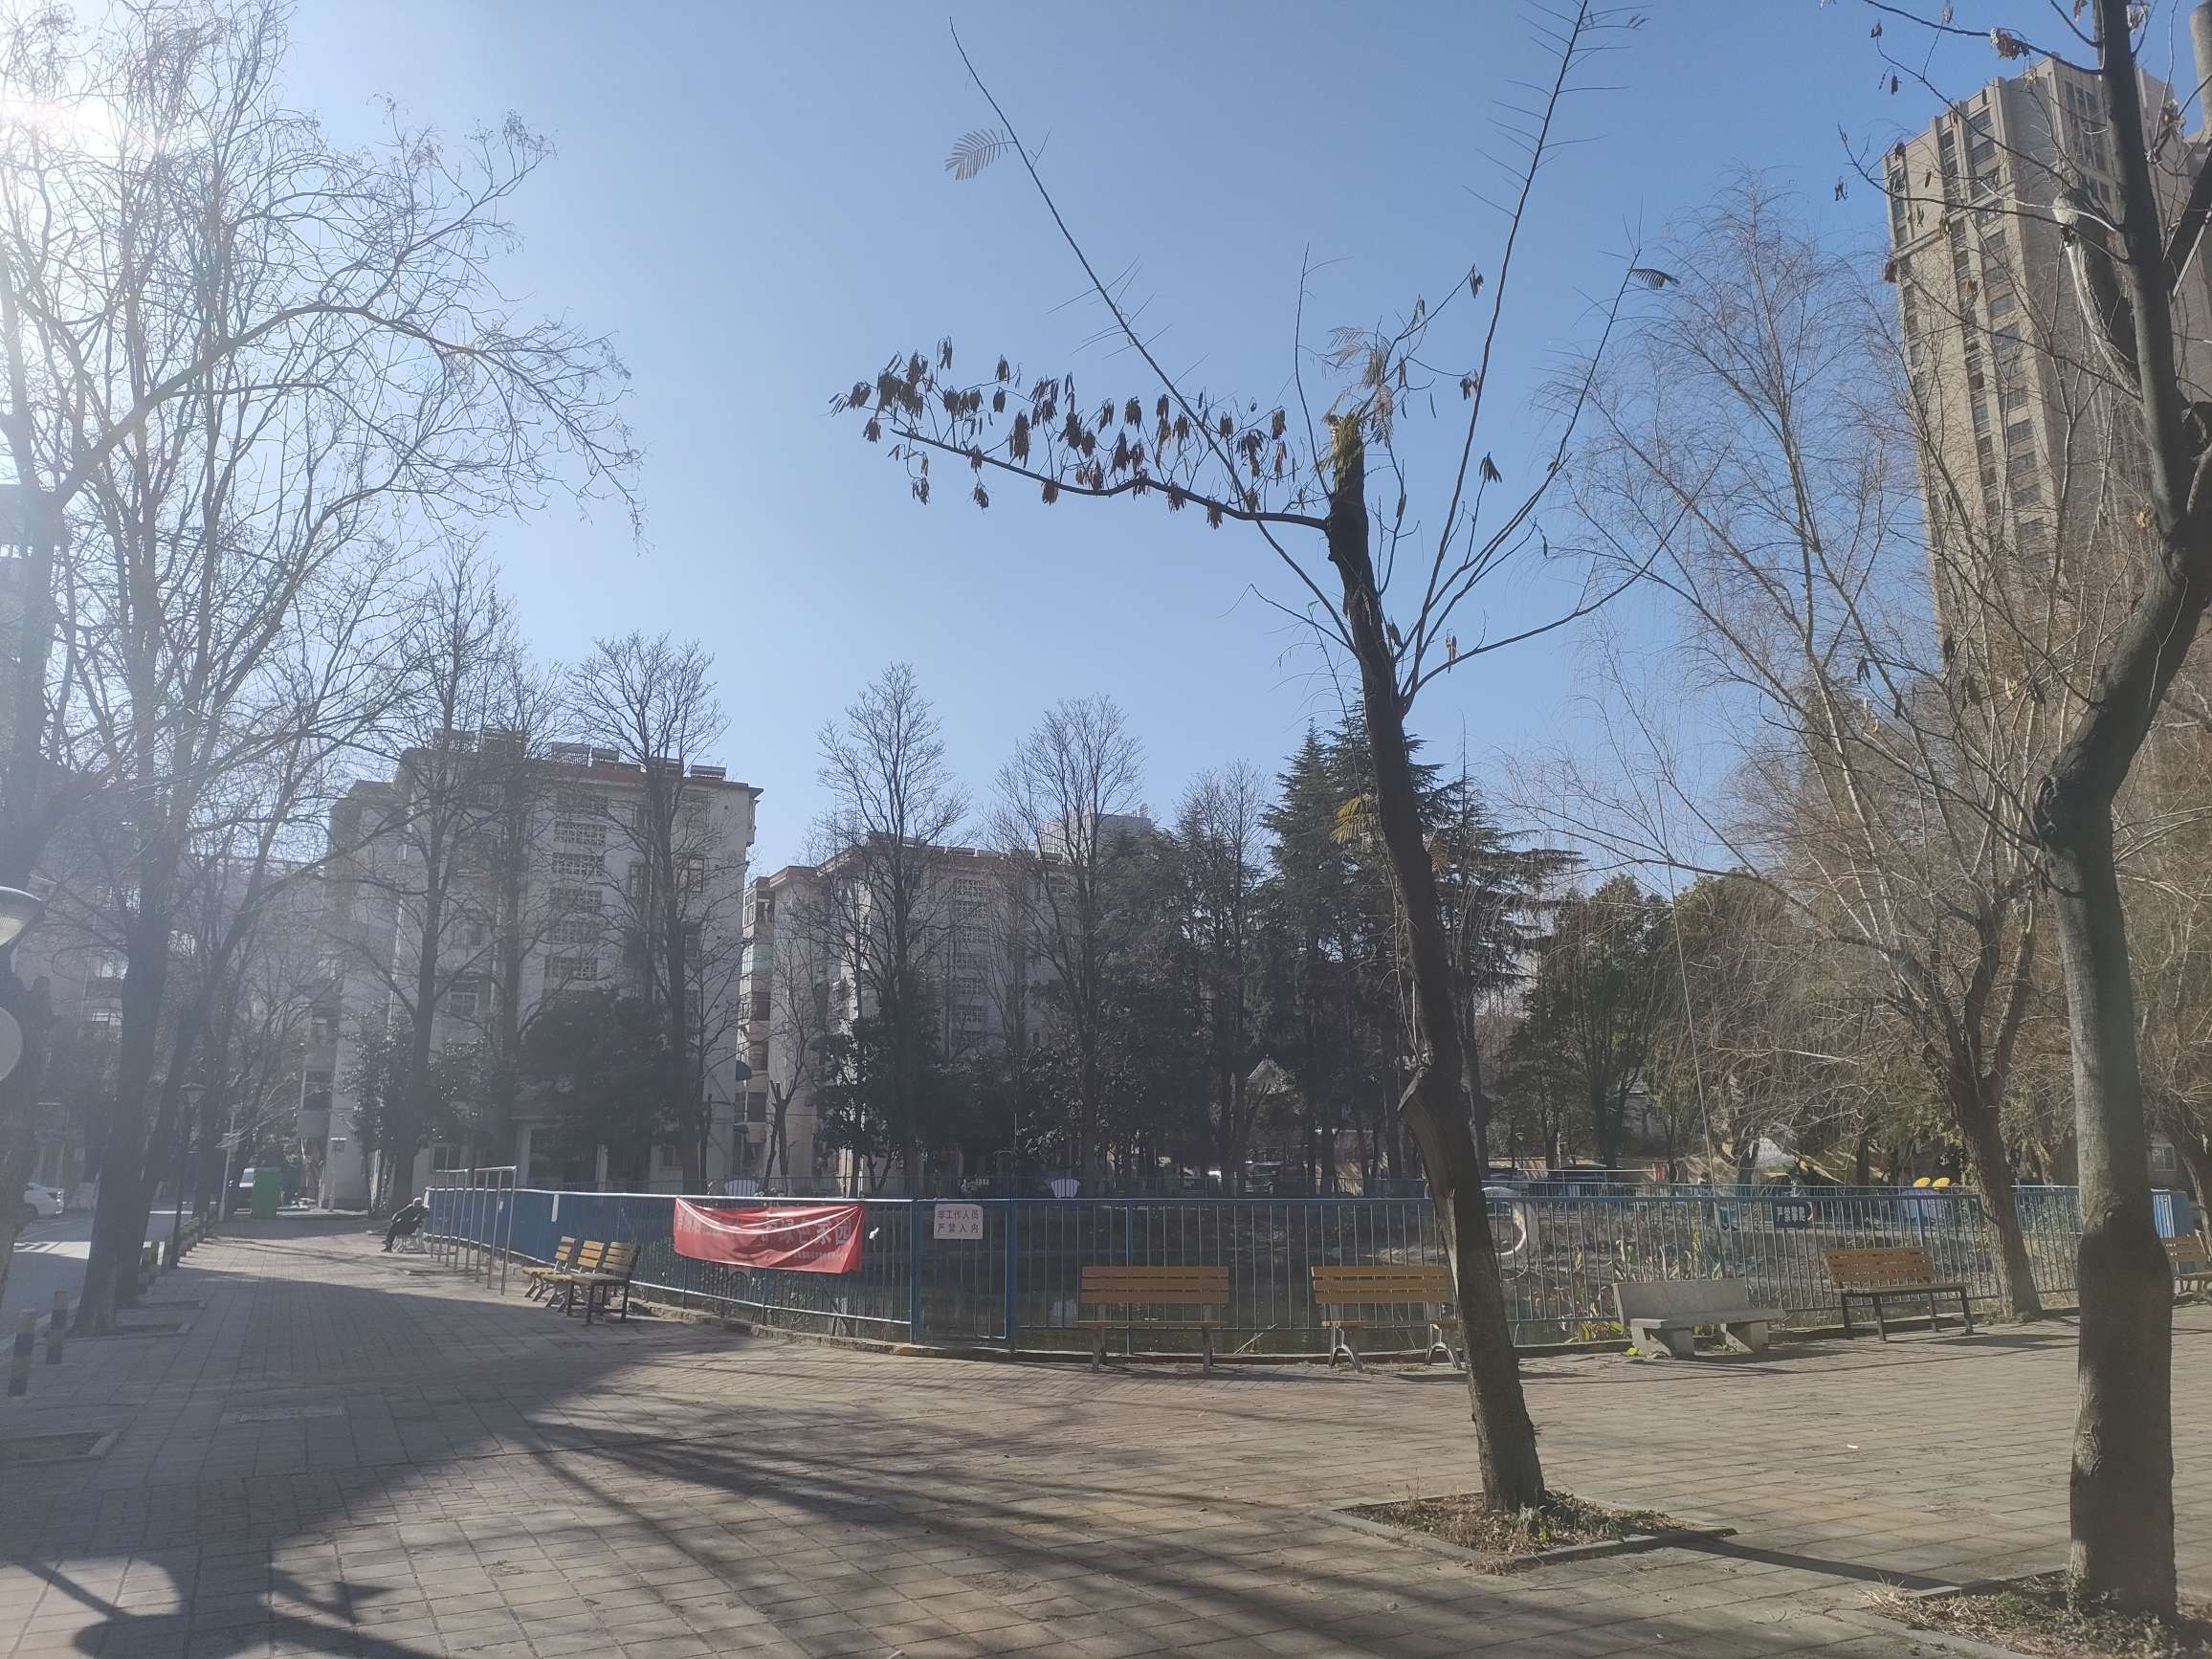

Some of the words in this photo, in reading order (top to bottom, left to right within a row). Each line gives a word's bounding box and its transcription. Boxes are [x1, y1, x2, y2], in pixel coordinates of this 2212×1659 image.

[937, 1208, 979, 1221] 非工作人员
[937, 1223, 979, 1233] 严禁入内
